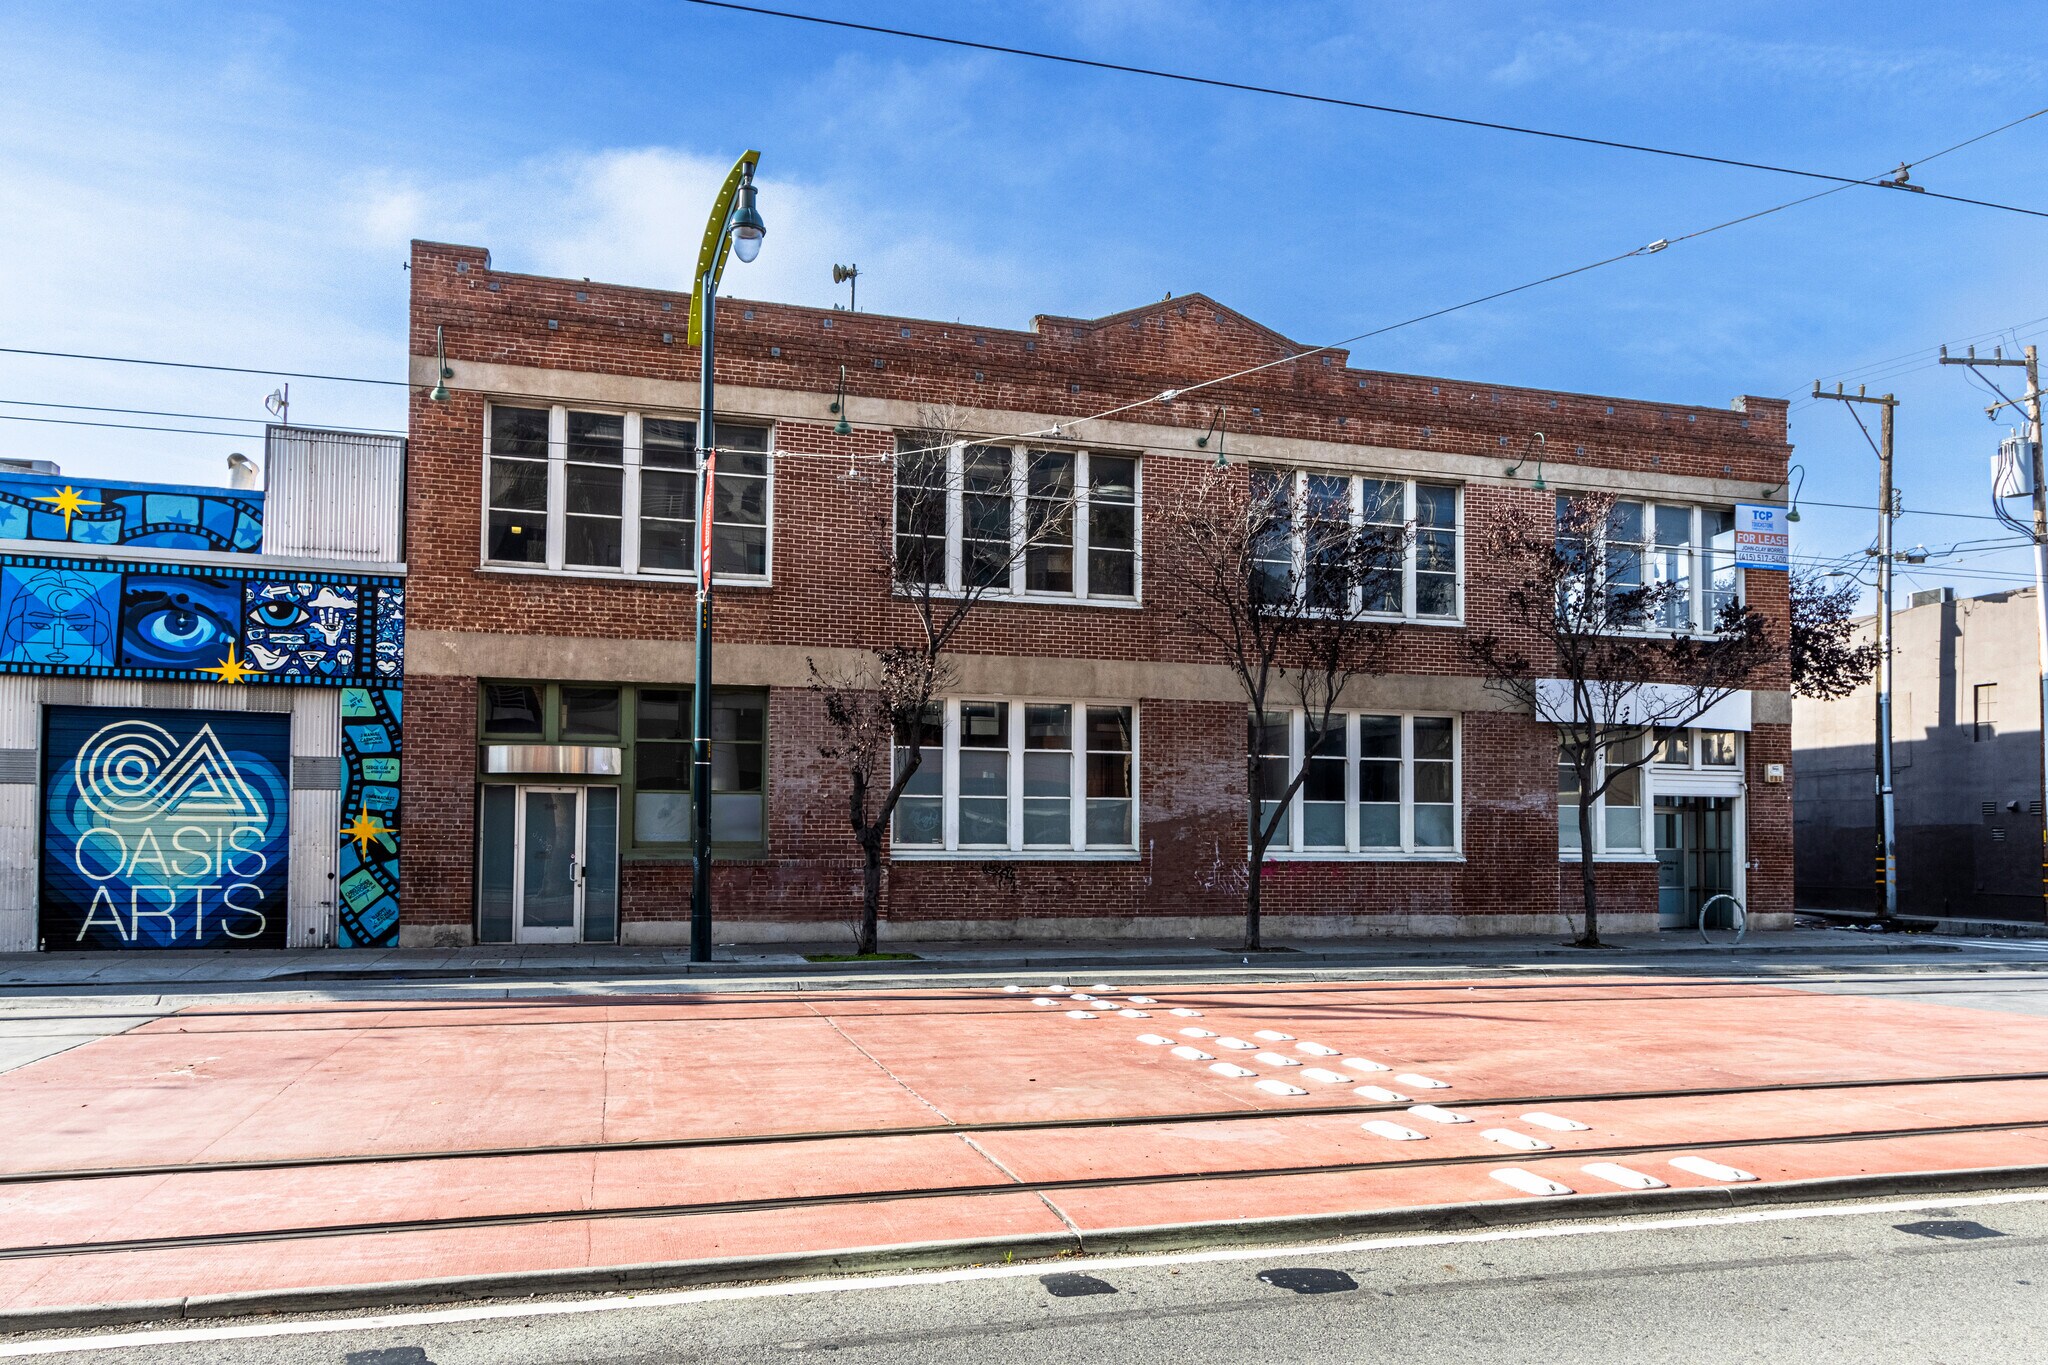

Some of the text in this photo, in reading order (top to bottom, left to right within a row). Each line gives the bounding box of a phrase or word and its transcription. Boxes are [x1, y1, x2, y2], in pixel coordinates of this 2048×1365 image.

[1752, 510, 1773, 521] TCP
[1737, 532, 1788, 546] FOR LEASE
[75, 826, 267, 881] OASIS
[76, 883, 267, 941] ARTS
